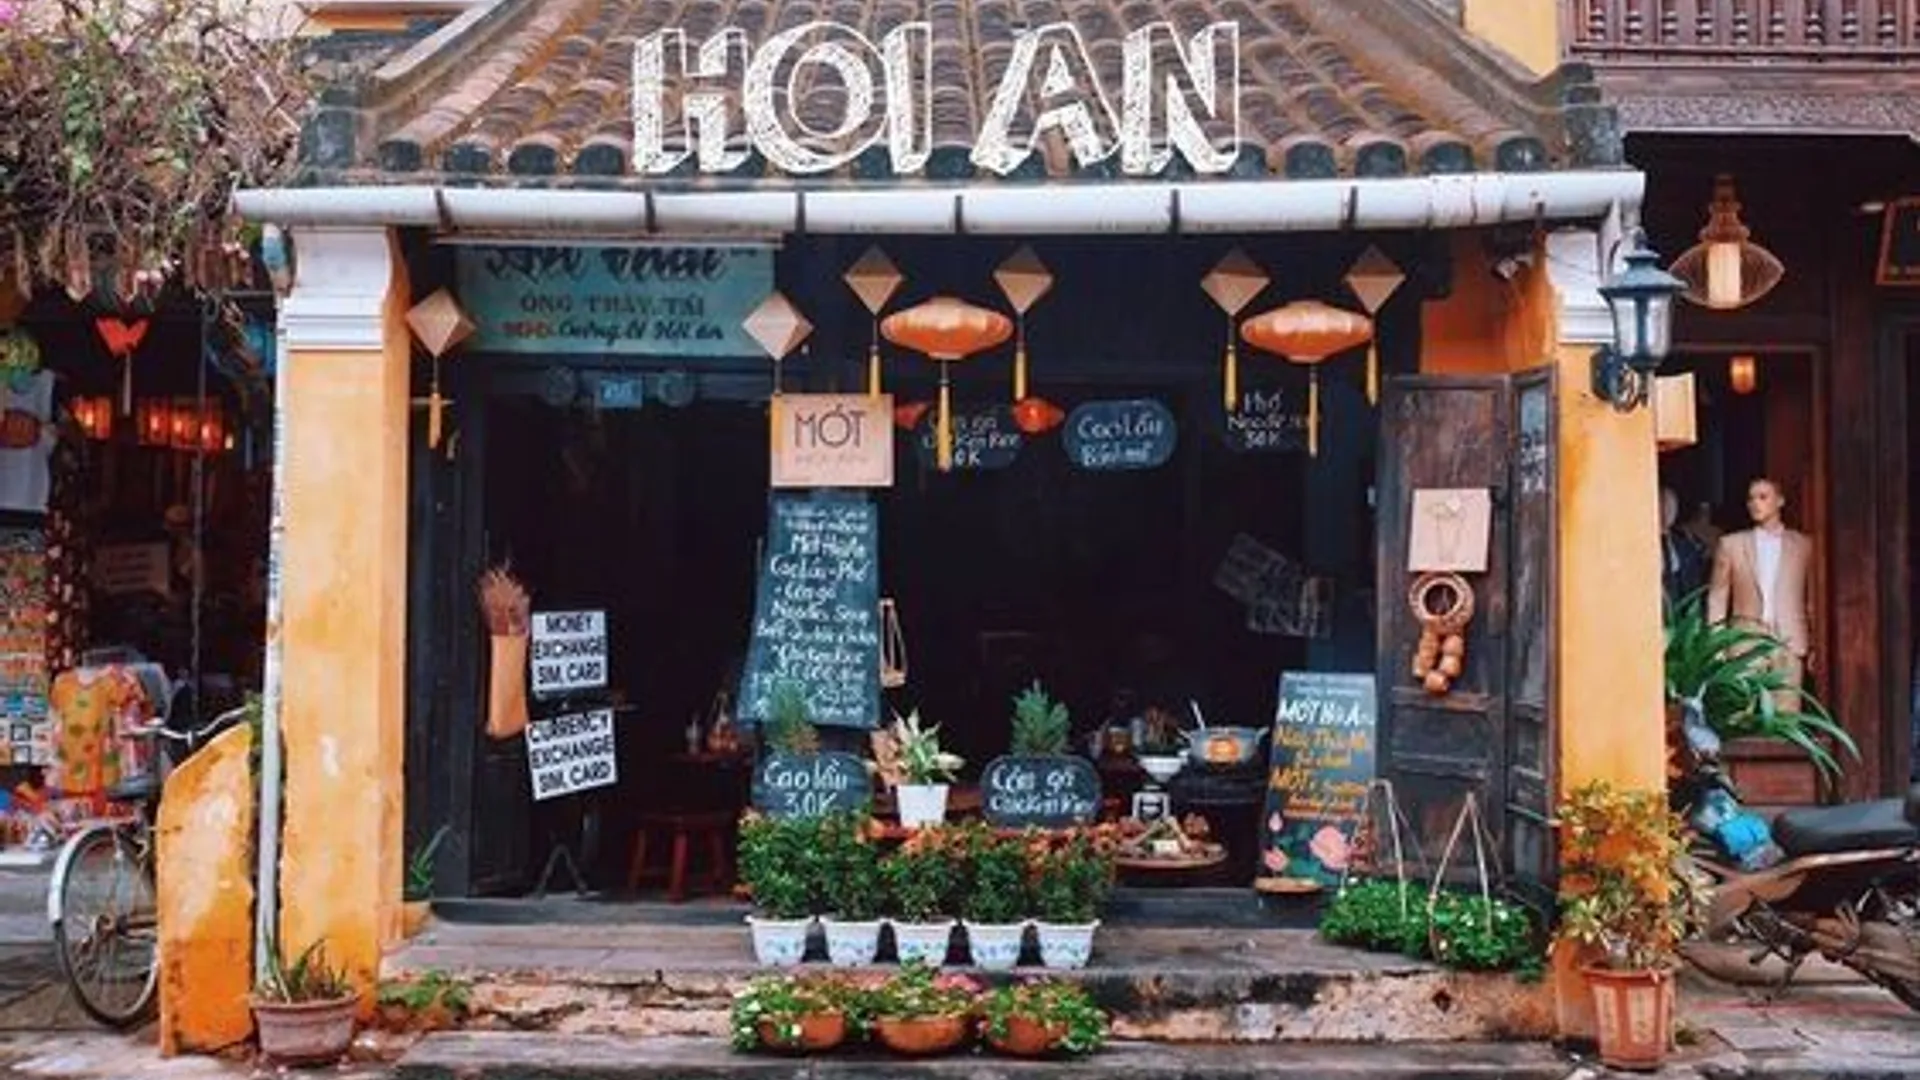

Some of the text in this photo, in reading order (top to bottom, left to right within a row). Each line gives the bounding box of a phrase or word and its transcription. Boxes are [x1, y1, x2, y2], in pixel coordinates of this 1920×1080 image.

[545, 613, 592, 633] MONEY
[535, 636, 606, 660] EXCHANGE
[566, 661, 602, 683] CARD
[532, 734, 614, 770] EXCHANGE
[569, 760, 611, 787] CARD
